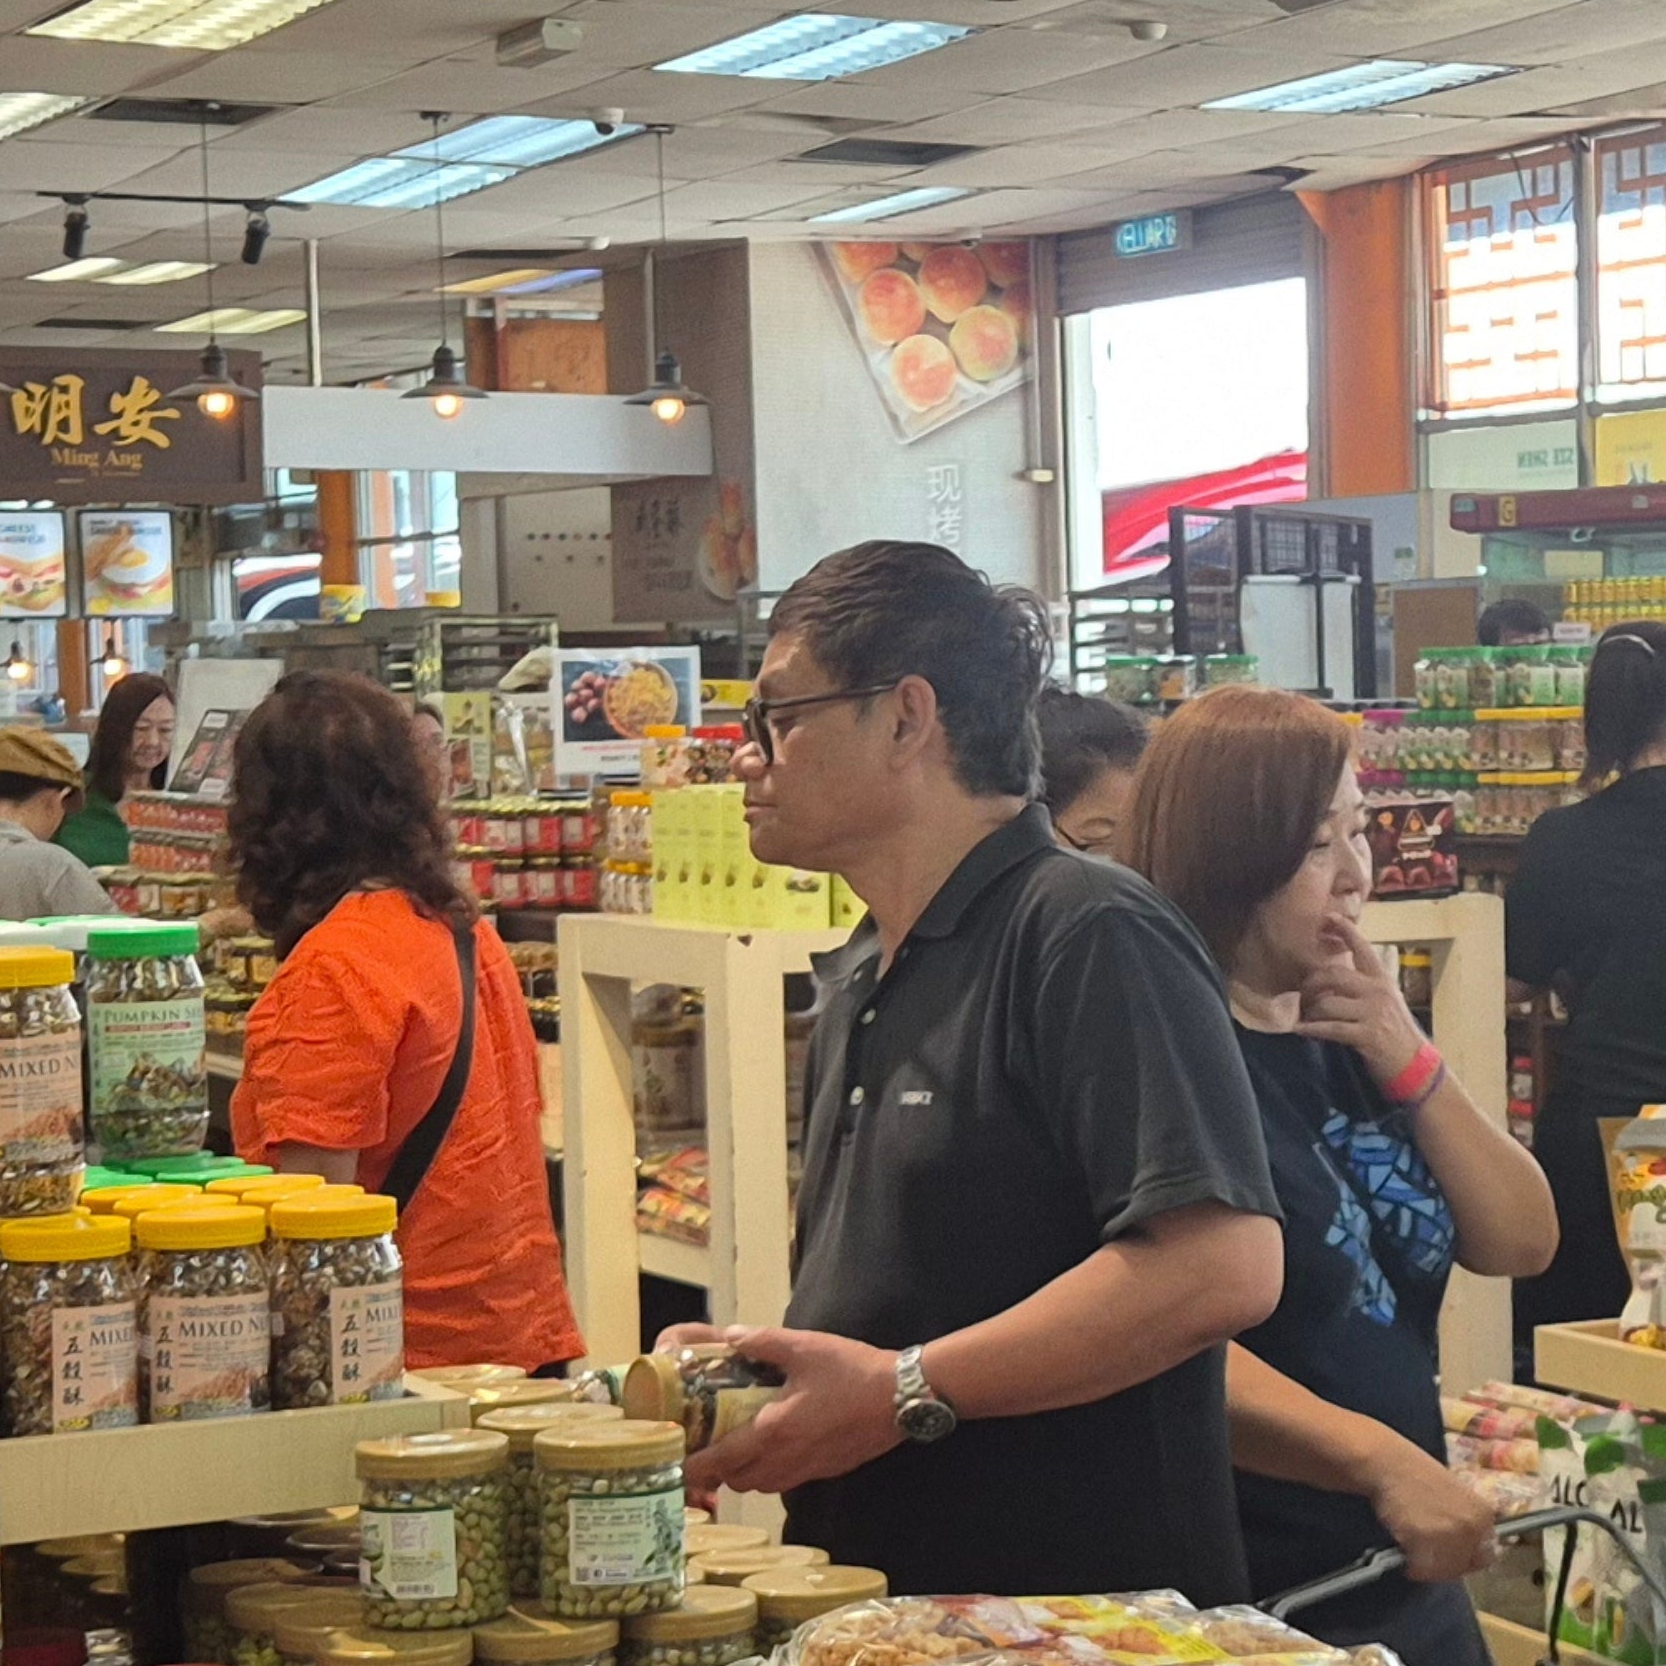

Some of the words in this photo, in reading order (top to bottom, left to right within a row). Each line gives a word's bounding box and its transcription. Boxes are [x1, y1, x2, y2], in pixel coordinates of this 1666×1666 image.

[11, 373, 181, 450] 明安
[51, 447, 100, 468] Ming
[104, 448, 143, 470] Ang
[104, 1009, 181, 1023] PUMPKIN
[180, 1318, 243, 1338] MIXED
[1611, 1499, 1642, 1533] AL
